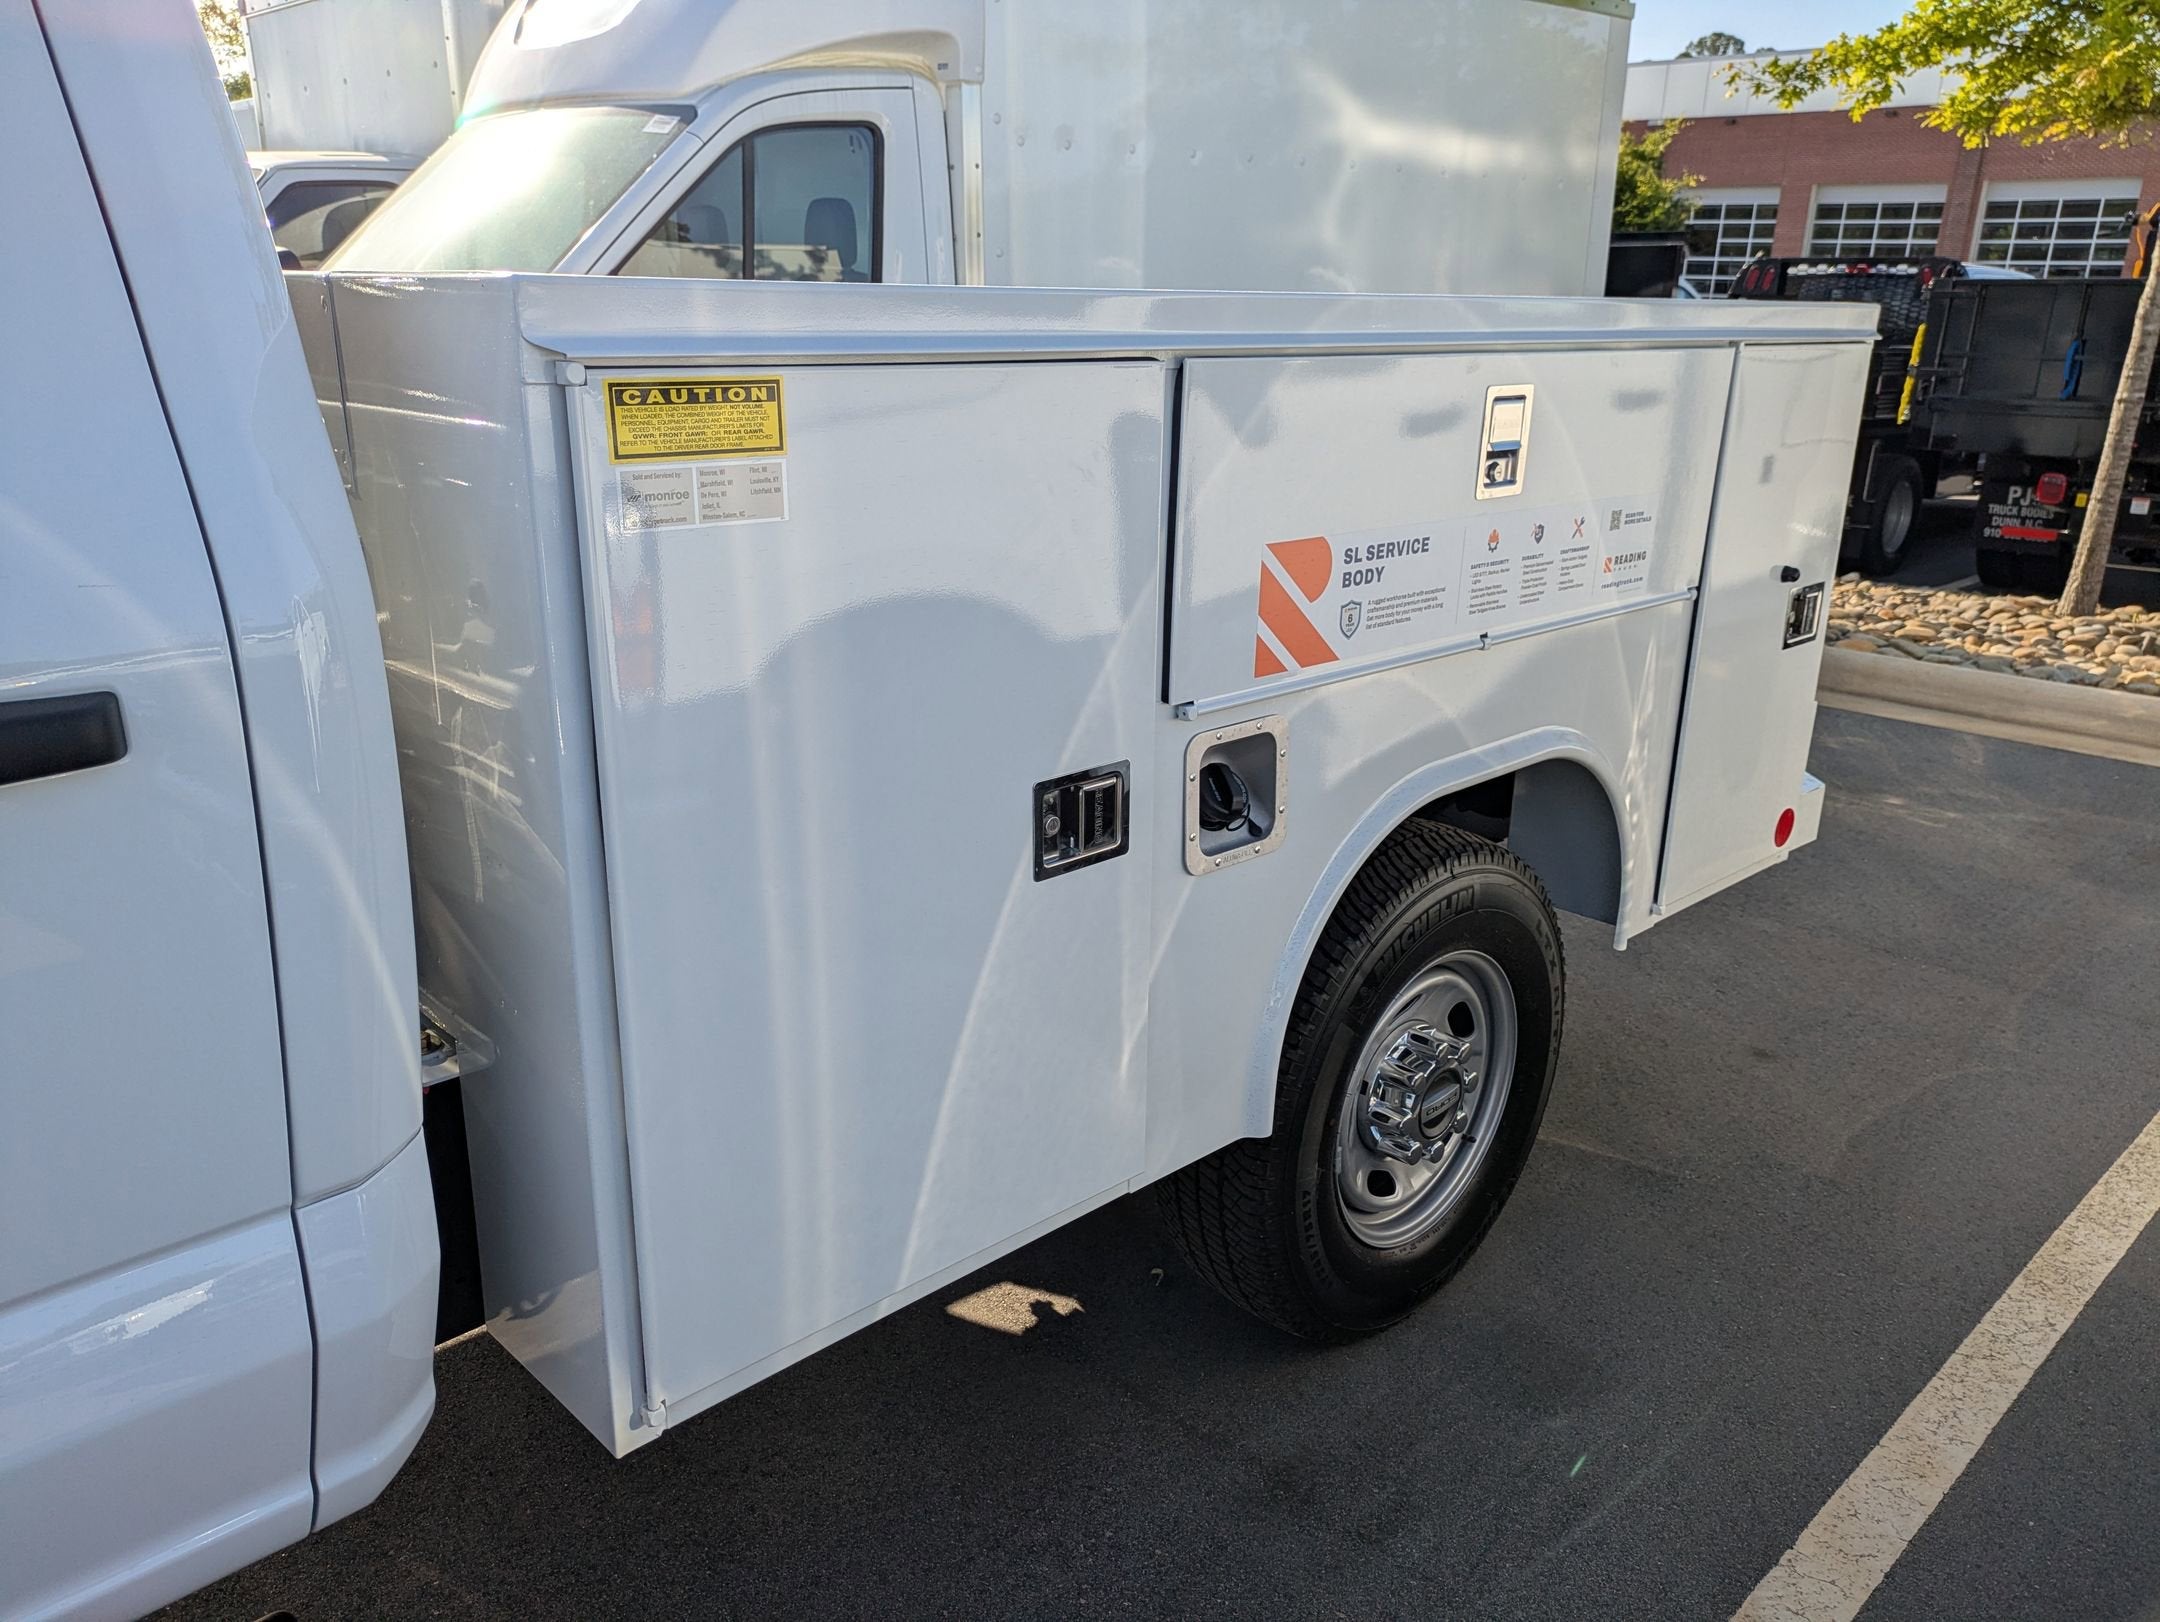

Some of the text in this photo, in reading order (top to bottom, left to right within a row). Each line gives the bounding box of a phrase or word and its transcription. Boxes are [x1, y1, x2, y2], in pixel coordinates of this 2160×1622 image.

[622, 387, 768, 405] CAUTION
[688, 422, 736, 432] MANUFACTURER'S
[683, 436, 730, 444] MANUFACTURER'S
[654, 472, 674, 480] Serviced
[644, 490, 690, 502] monroe
[1988, 503, 2054, 519] TRUCK BODIES
[1984, 526, 2002, 538] 910
[1344, 536, 1430, 564] SL SERVICE
[1614, 550, 1646, 566] READING
[1342, 566, 1385, 588] BODY
[1601, 576, 1644, 589] readingtruck.com
[1372, 598, 1386, 606] rugged
[1387, 594, 1407, 602] workhorse
[1425, 587, 1446, 595] exceptional
[1366, 604, 1395, 614] craftsmanship
[1366, 614, 1374, 622] Get
[1411, 606, 1423, 614] money
[1348, 613, 1354, 623] 6
[1378, 619, 1394, 628] standard
[1372, 884, 1475, 982] MICHELIN
[1426, 1091, 1458, 1117] FORD
